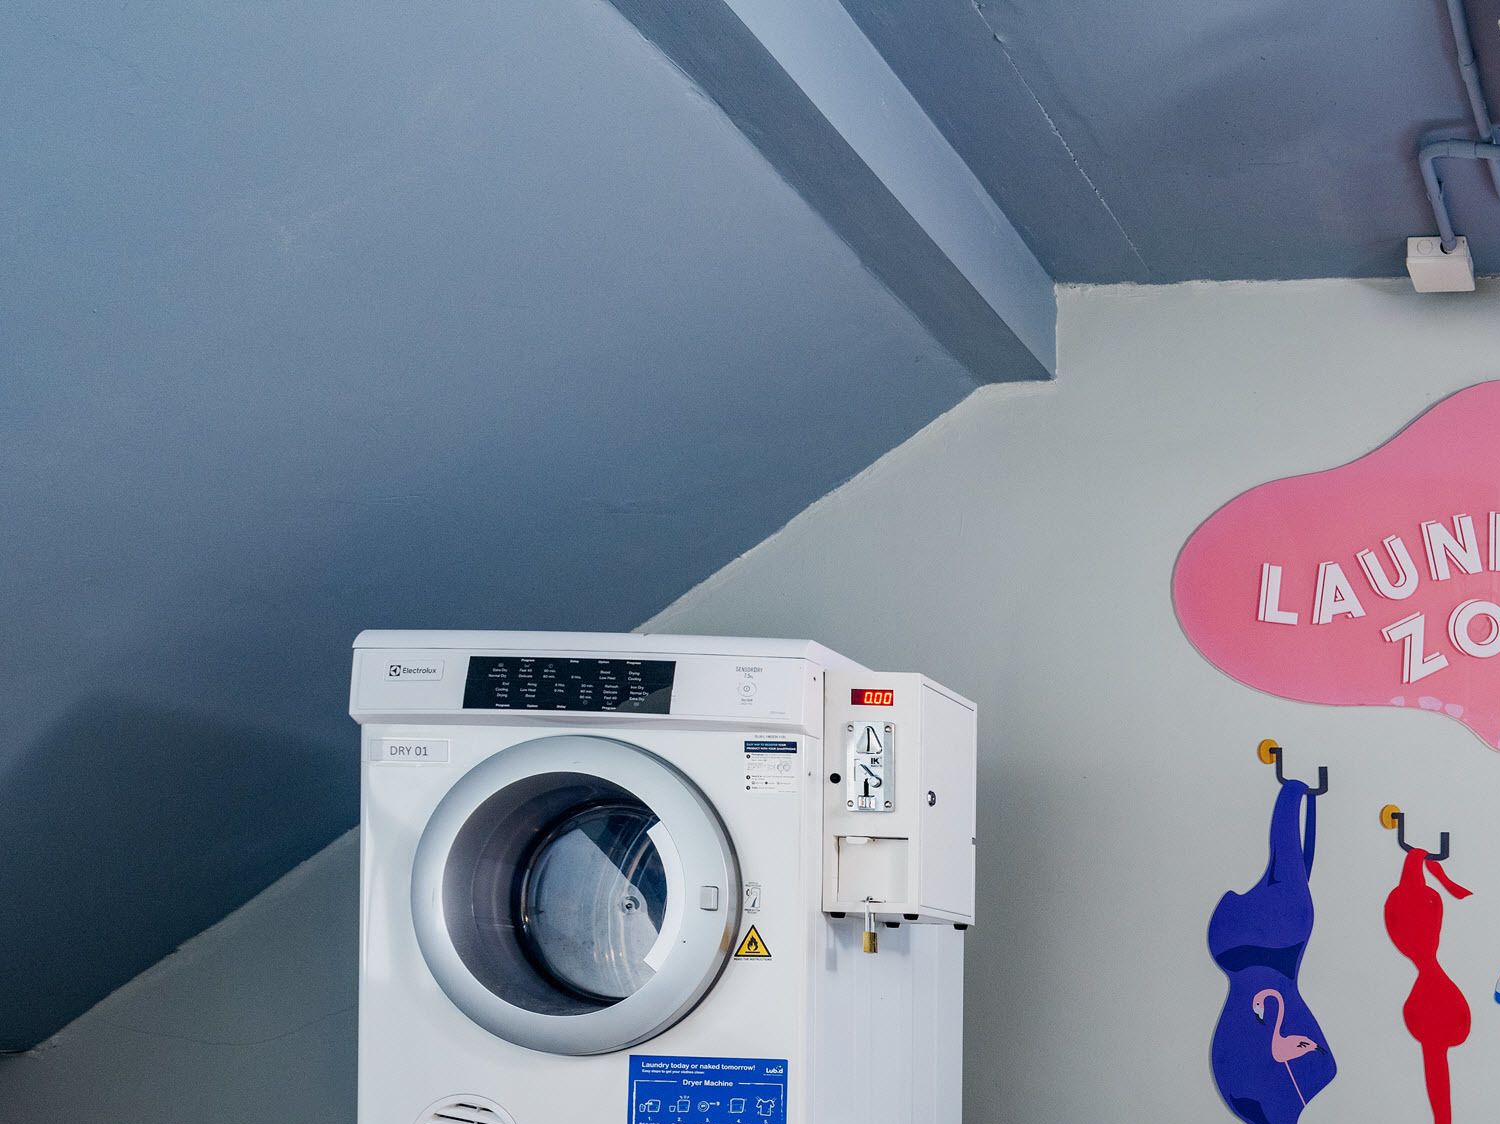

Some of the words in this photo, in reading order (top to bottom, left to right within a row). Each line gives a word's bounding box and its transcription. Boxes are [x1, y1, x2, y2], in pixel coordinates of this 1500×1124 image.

[864, 692, 893, 704] 0.00
[390, 746, 412, 755] DRY
[415, 746, 428, 756] 01
[641, 1061, 670, 1069] Laundry
[671, 1062, 690, 1070] today
[699, 1063, 720, 1071] naked
[682, 1079, 702, 1087] Dryer
